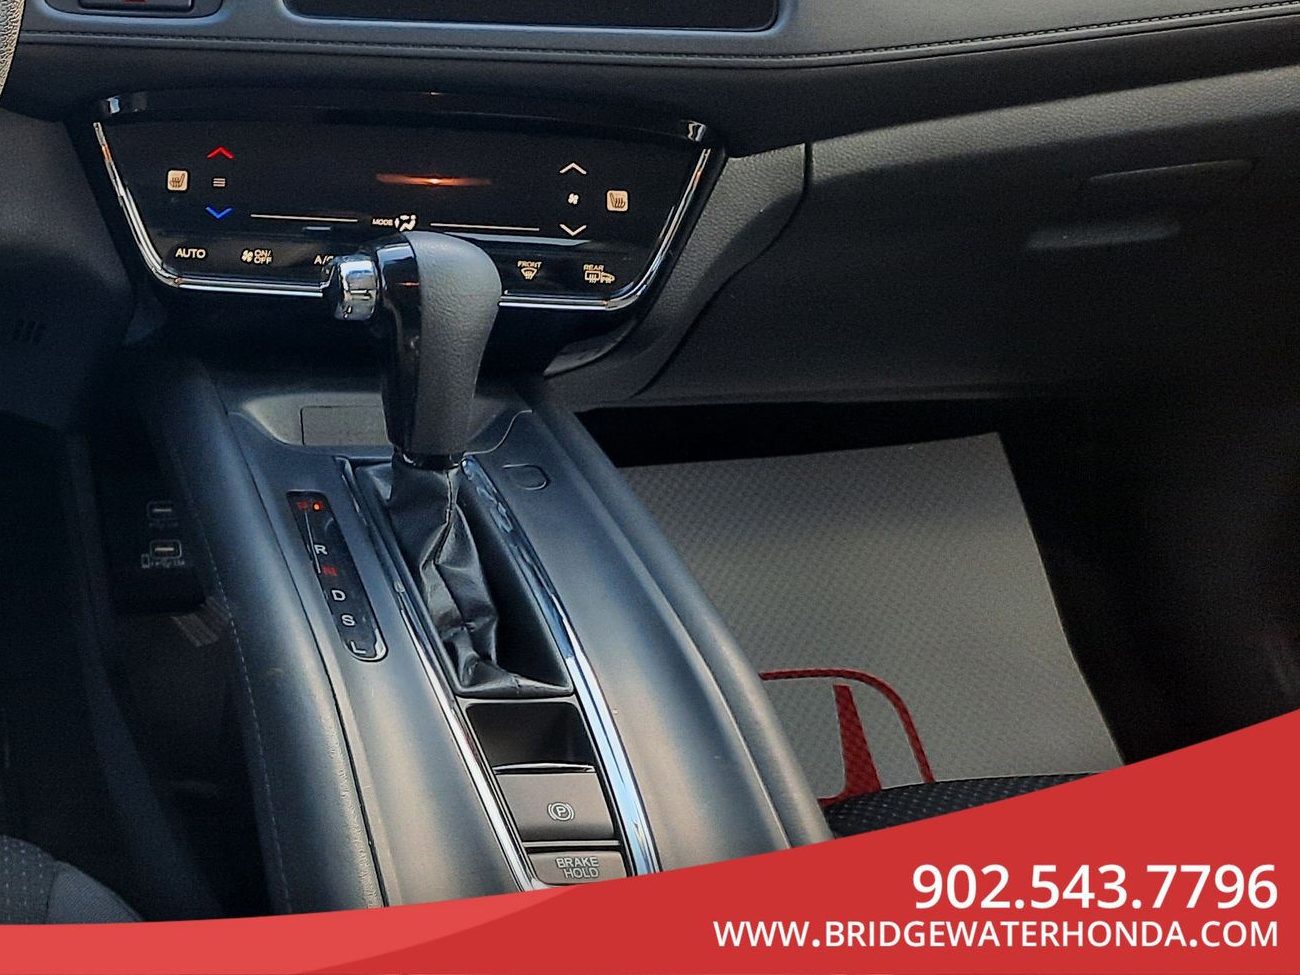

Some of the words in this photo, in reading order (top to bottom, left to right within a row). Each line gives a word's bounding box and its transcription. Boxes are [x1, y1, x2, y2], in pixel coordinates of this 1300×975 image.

[372, 218, 393, 226] MODE
[175, 248, 206, 259] AUTO
[253, 256, 272, 264] OFF
[314, 544, 327, 555] R
[331, 589, 346, 601] D
[341, 614, 356, 626] S
[350, 641, 366, 654] L
[556, 857, 599, 868] BRAKE
[563, 867, 599, 879] HOLD
